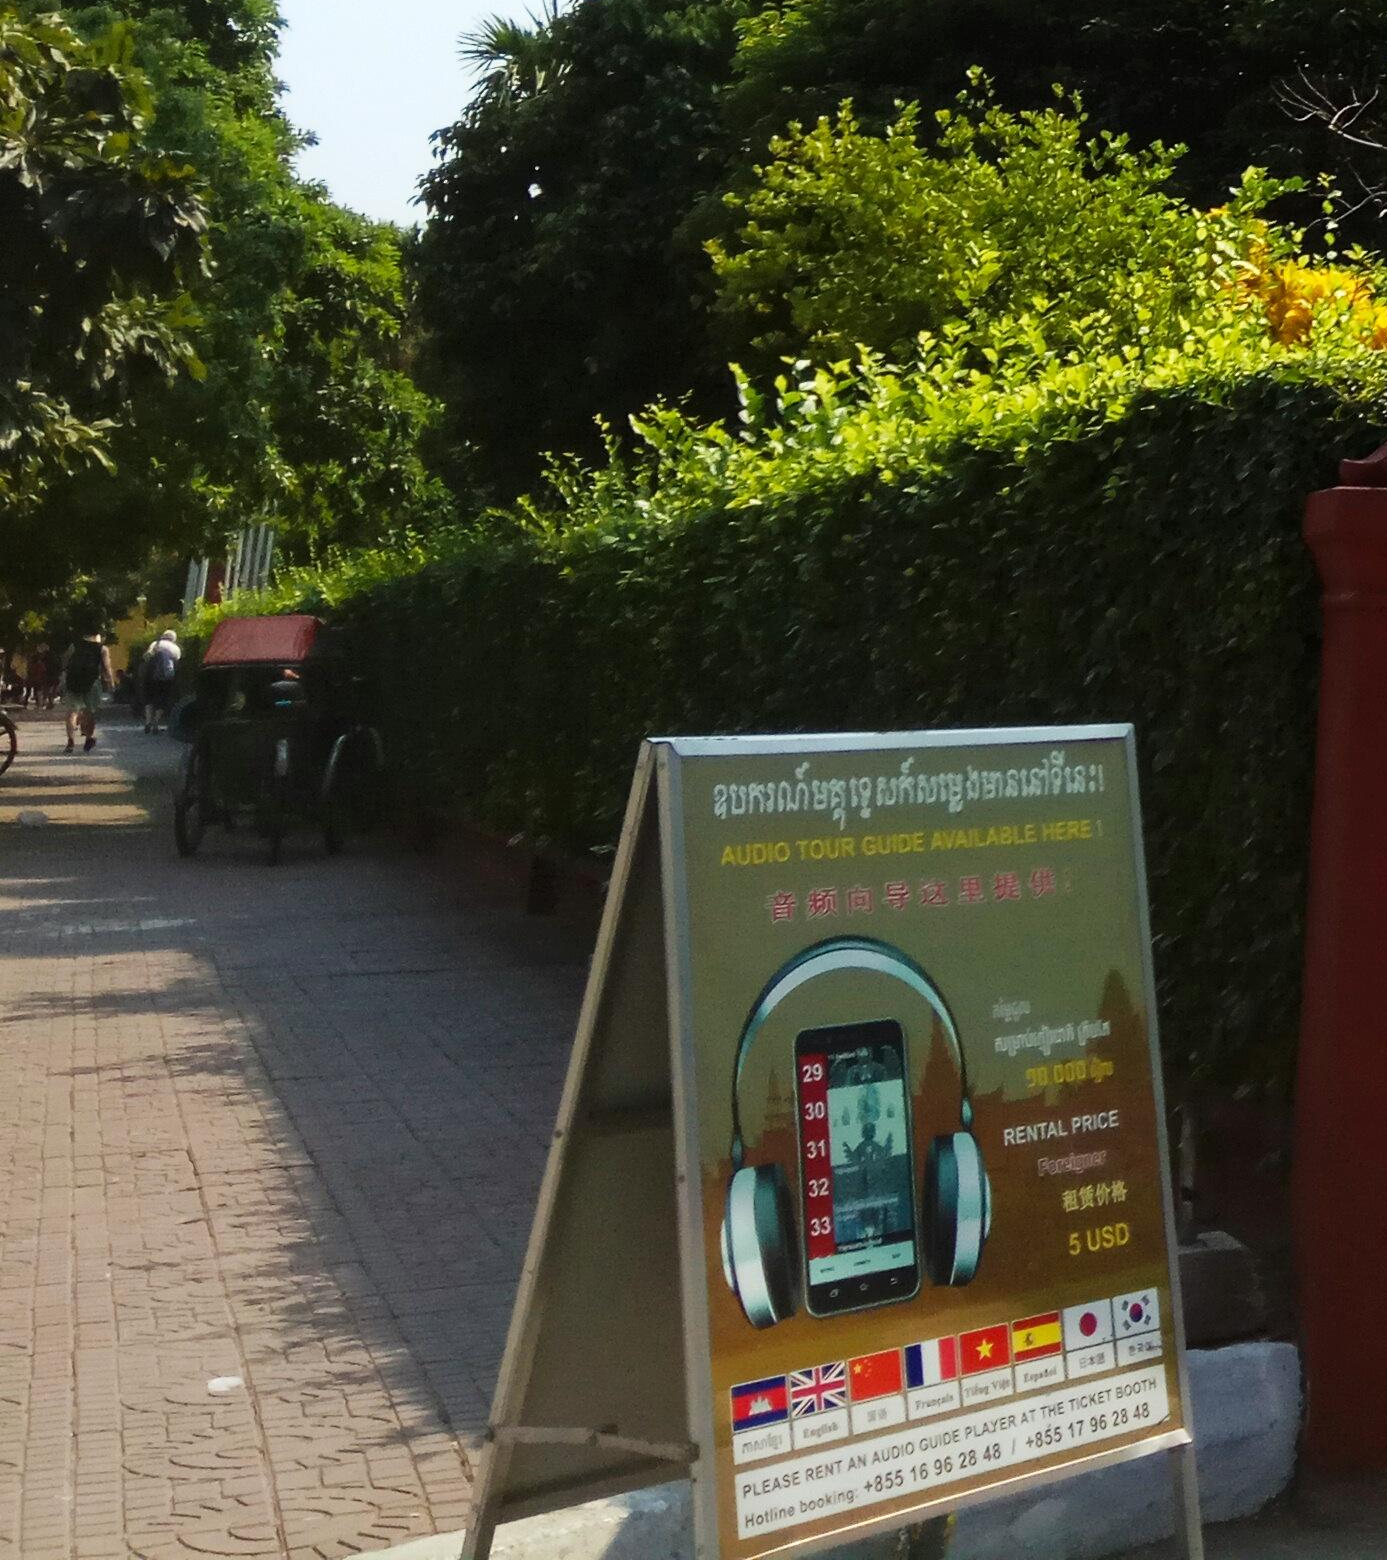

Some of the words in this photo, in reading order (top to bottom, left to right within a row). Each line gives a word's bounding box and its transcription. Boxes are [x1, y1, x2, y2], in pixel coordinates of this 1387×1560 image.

[720, 841, 791, 866] AUDIO
[796, 837, 856, 861] TOUR
[861, 831, 925, 855] GUIDE
[930, 824, 1038, 851] AVAILABLE
[1043, 819, 1093, 842] HERE
[802, 1063, 824, 1083] 29
[804, 1101, 826, 1121] 30
[1003, 1119, 1069, 1146] RENTAL
[1072, 1109, 1120, 1135] PRICE
[806, 1140, 826, 1159] 31
[1037, 1149, 1107, 1176] Foreigner
[808, 1178, 830, 1198] 32
[1062, 1178, 1129, 1214] 租赁价格
[810, 1216, 832, 1236] 33
[1068, 1232, 1081, 1256] 5
[1086, 1222, 1131, 1254] USD
[742, 1471, 801, 1499] PLEASE
[805, 1460, 843, 1482] RENT
[847, 1453, 867, 1471] AN
[871, 1441, 914, 1465] AUDIO
[919, 1428, 960, 1451] GUIDE
[965, 1414, 1017, 1439] PLAYER
[1020, 1409, 1036, 1425] AT
[1041, 1402, 1065, 1420] THE
[1069, 1388, 1112, 1411] TICKET
[1115, 1377, 1157, 1400] BOOTH
[802, 1421, 839, 1440] English
[744, 1501, 796, 1528] Hotline
[799, 1488, 858, 1514] booking:
[864, 1471, 904, 1495] +855
[909, 1463, 929, 1482] 16
[933, 1456, 953, 1476] 96
[958, 1448, 978, 1469] 28
[982, 1442, 1002, 1462] 48
[1025, 1426, 1063, 1449] +855
[1067, 1419, 1085, 1439] 17
[1089, 1414, 1108, 1434] 96
[1111, 1407, 1129, 1427] 28
[1132, 1401, 1151, 1420] 48
